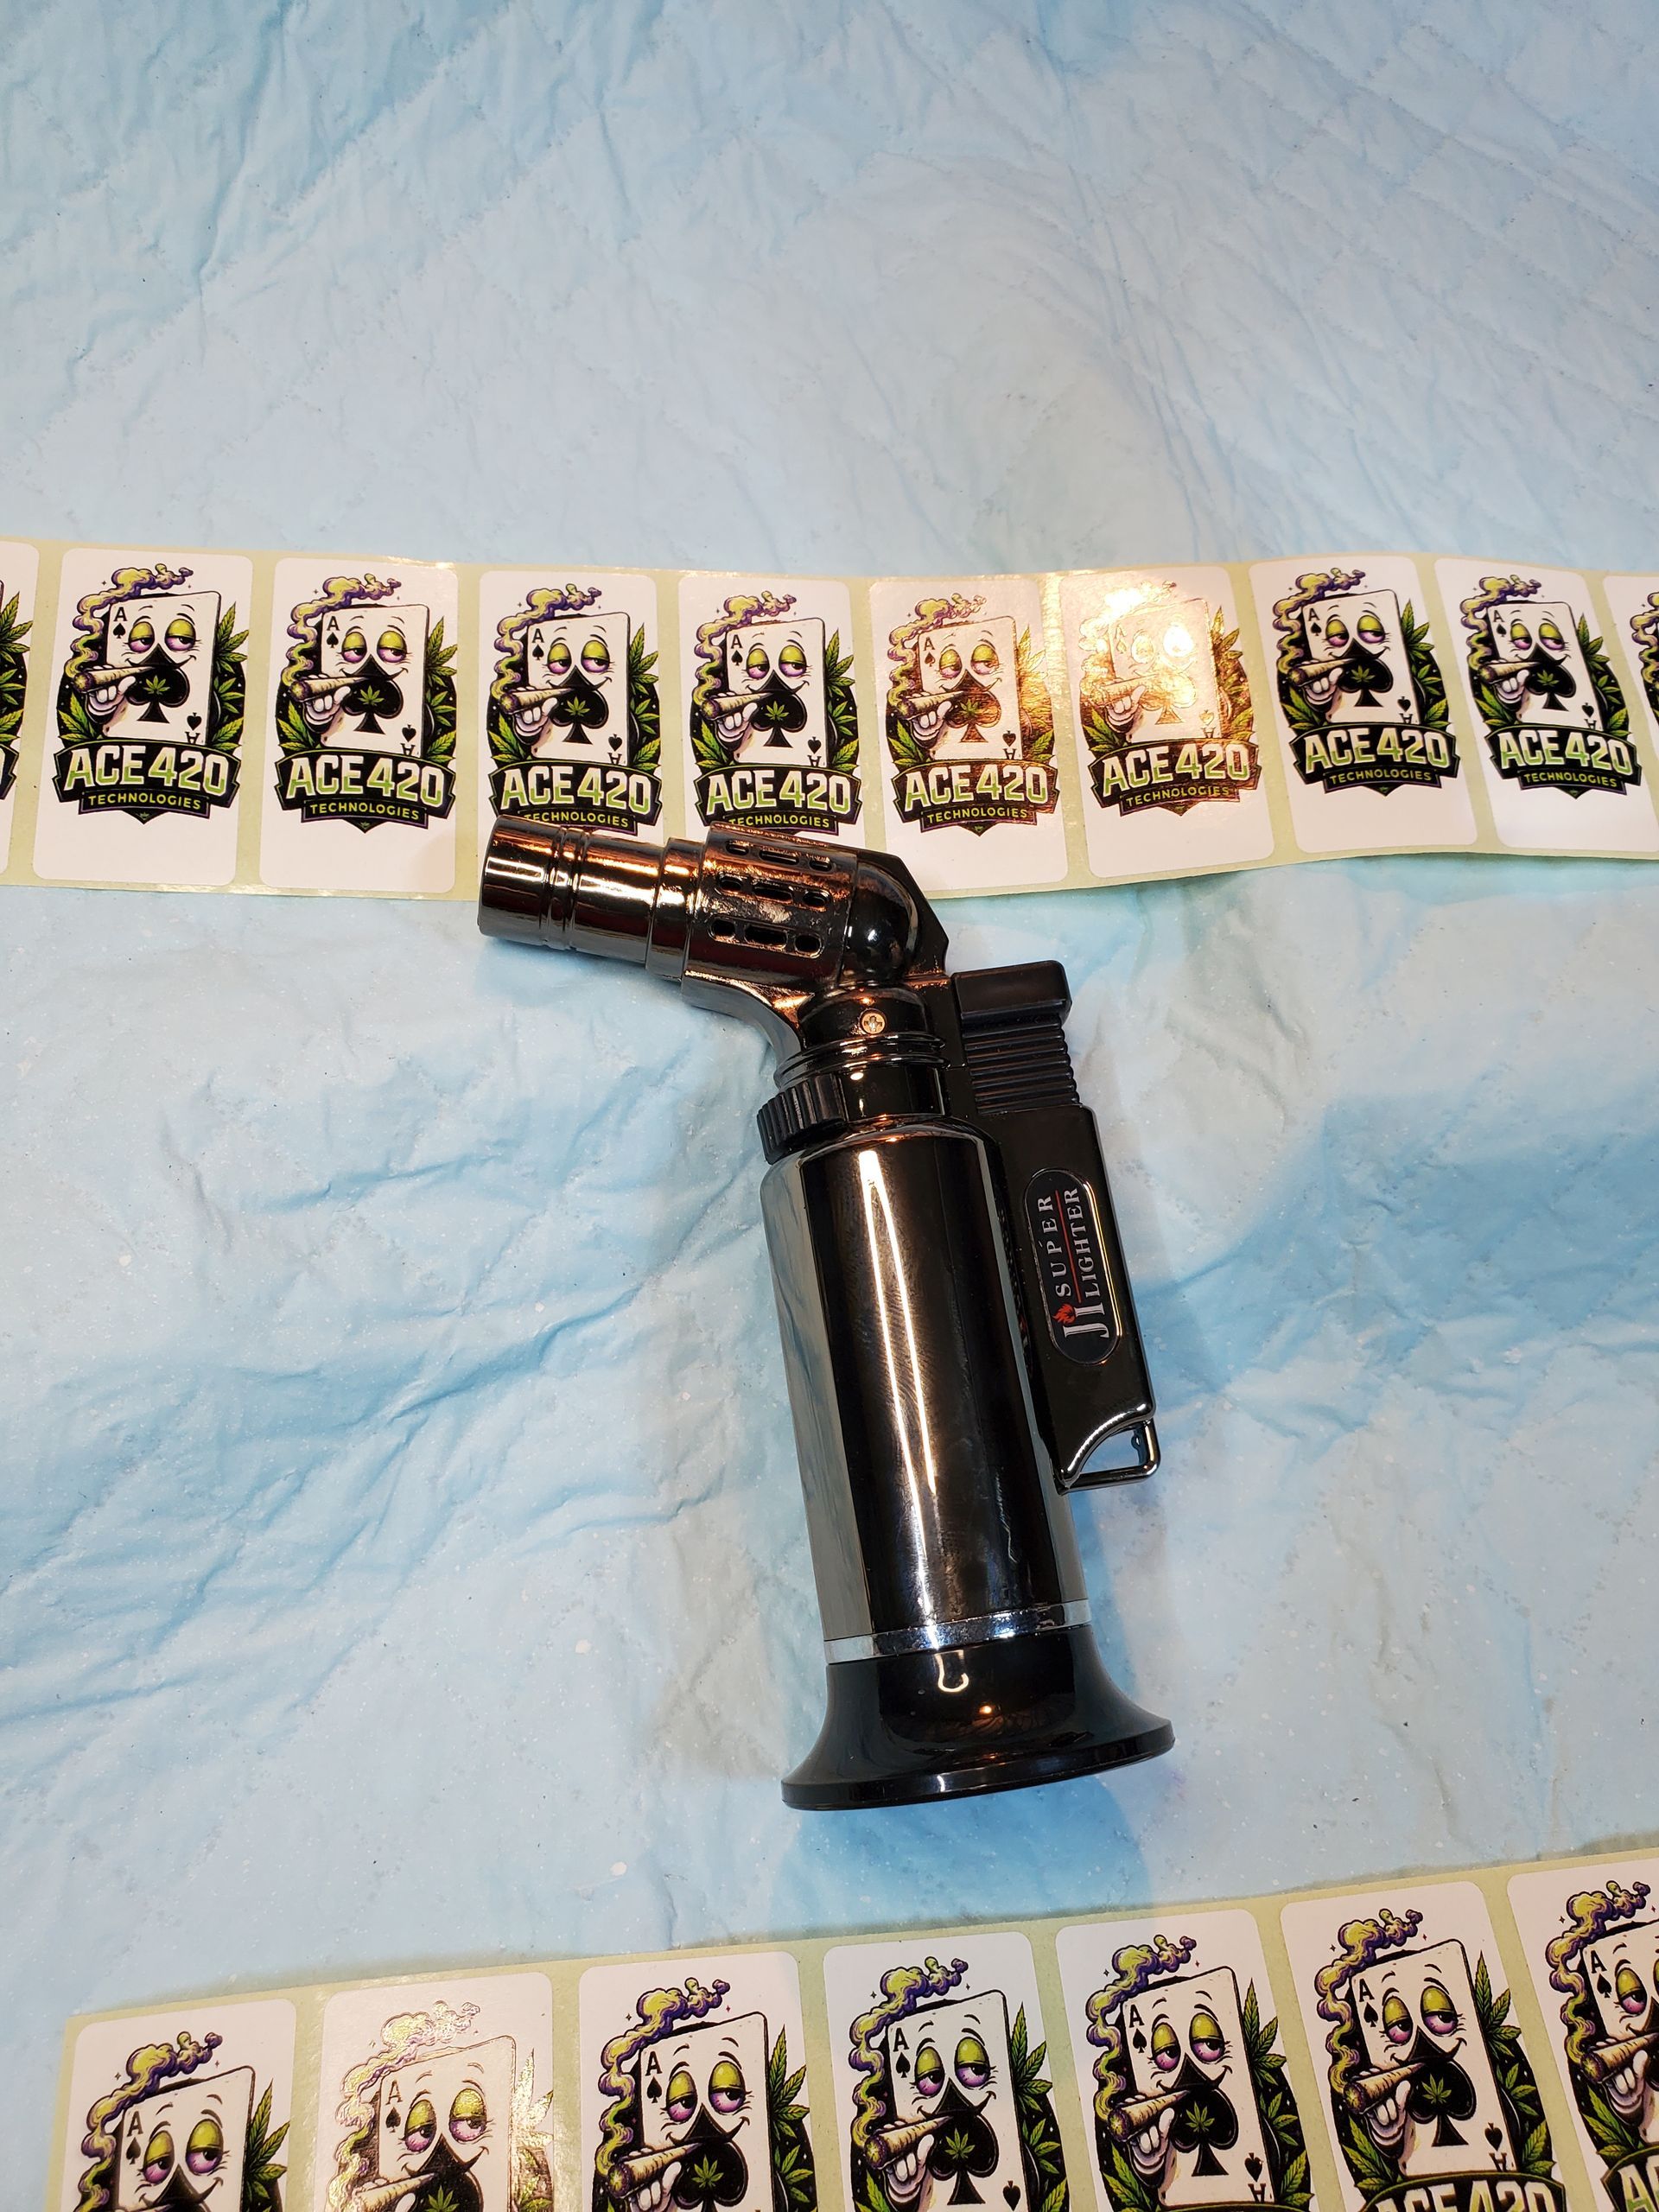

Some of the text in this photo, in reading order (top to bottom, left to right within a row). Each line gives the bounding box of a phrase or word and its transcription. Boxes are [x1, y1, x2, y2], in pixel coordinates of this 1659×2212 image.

[113, 607, 128, 621] A
[327, 615, 340, 631] A
[1307, 607, 1320, 621] A
[1492, 609, 1504, 623] A
[531, 628, 545, 643] A
[730, 633, 743, 649] A
[923, 636, 936, 651] A
[1330, 768, 1432, 785] TECHNOLOGIES
[1523, 772, 1618, 787] TECHNOLOGIES
[88, 792, 201, 810] TECHNOLOGIES
[1126, 785, 1230, 807] TECHNOLOGIES
[310, 802, 420, 820] TECHNOLOGIES
[926, 806, 1028, 823] TECHNOLOGIES
[1038, 1196, 1071, 1298] SUPER
[1064, 1188, 1101, 1298] LIGHTER
[1590, 1950, 1608, 1974] A
[1358, 1978, 1375, 2002] A
[1128, 2004, 1145, 2028] A
[893, 2027, 910, 2052] A
[645, 2050, 662, 2076] A
[385, 2080, 404, 2106] A
[126, 2111, 143, 2137] A
